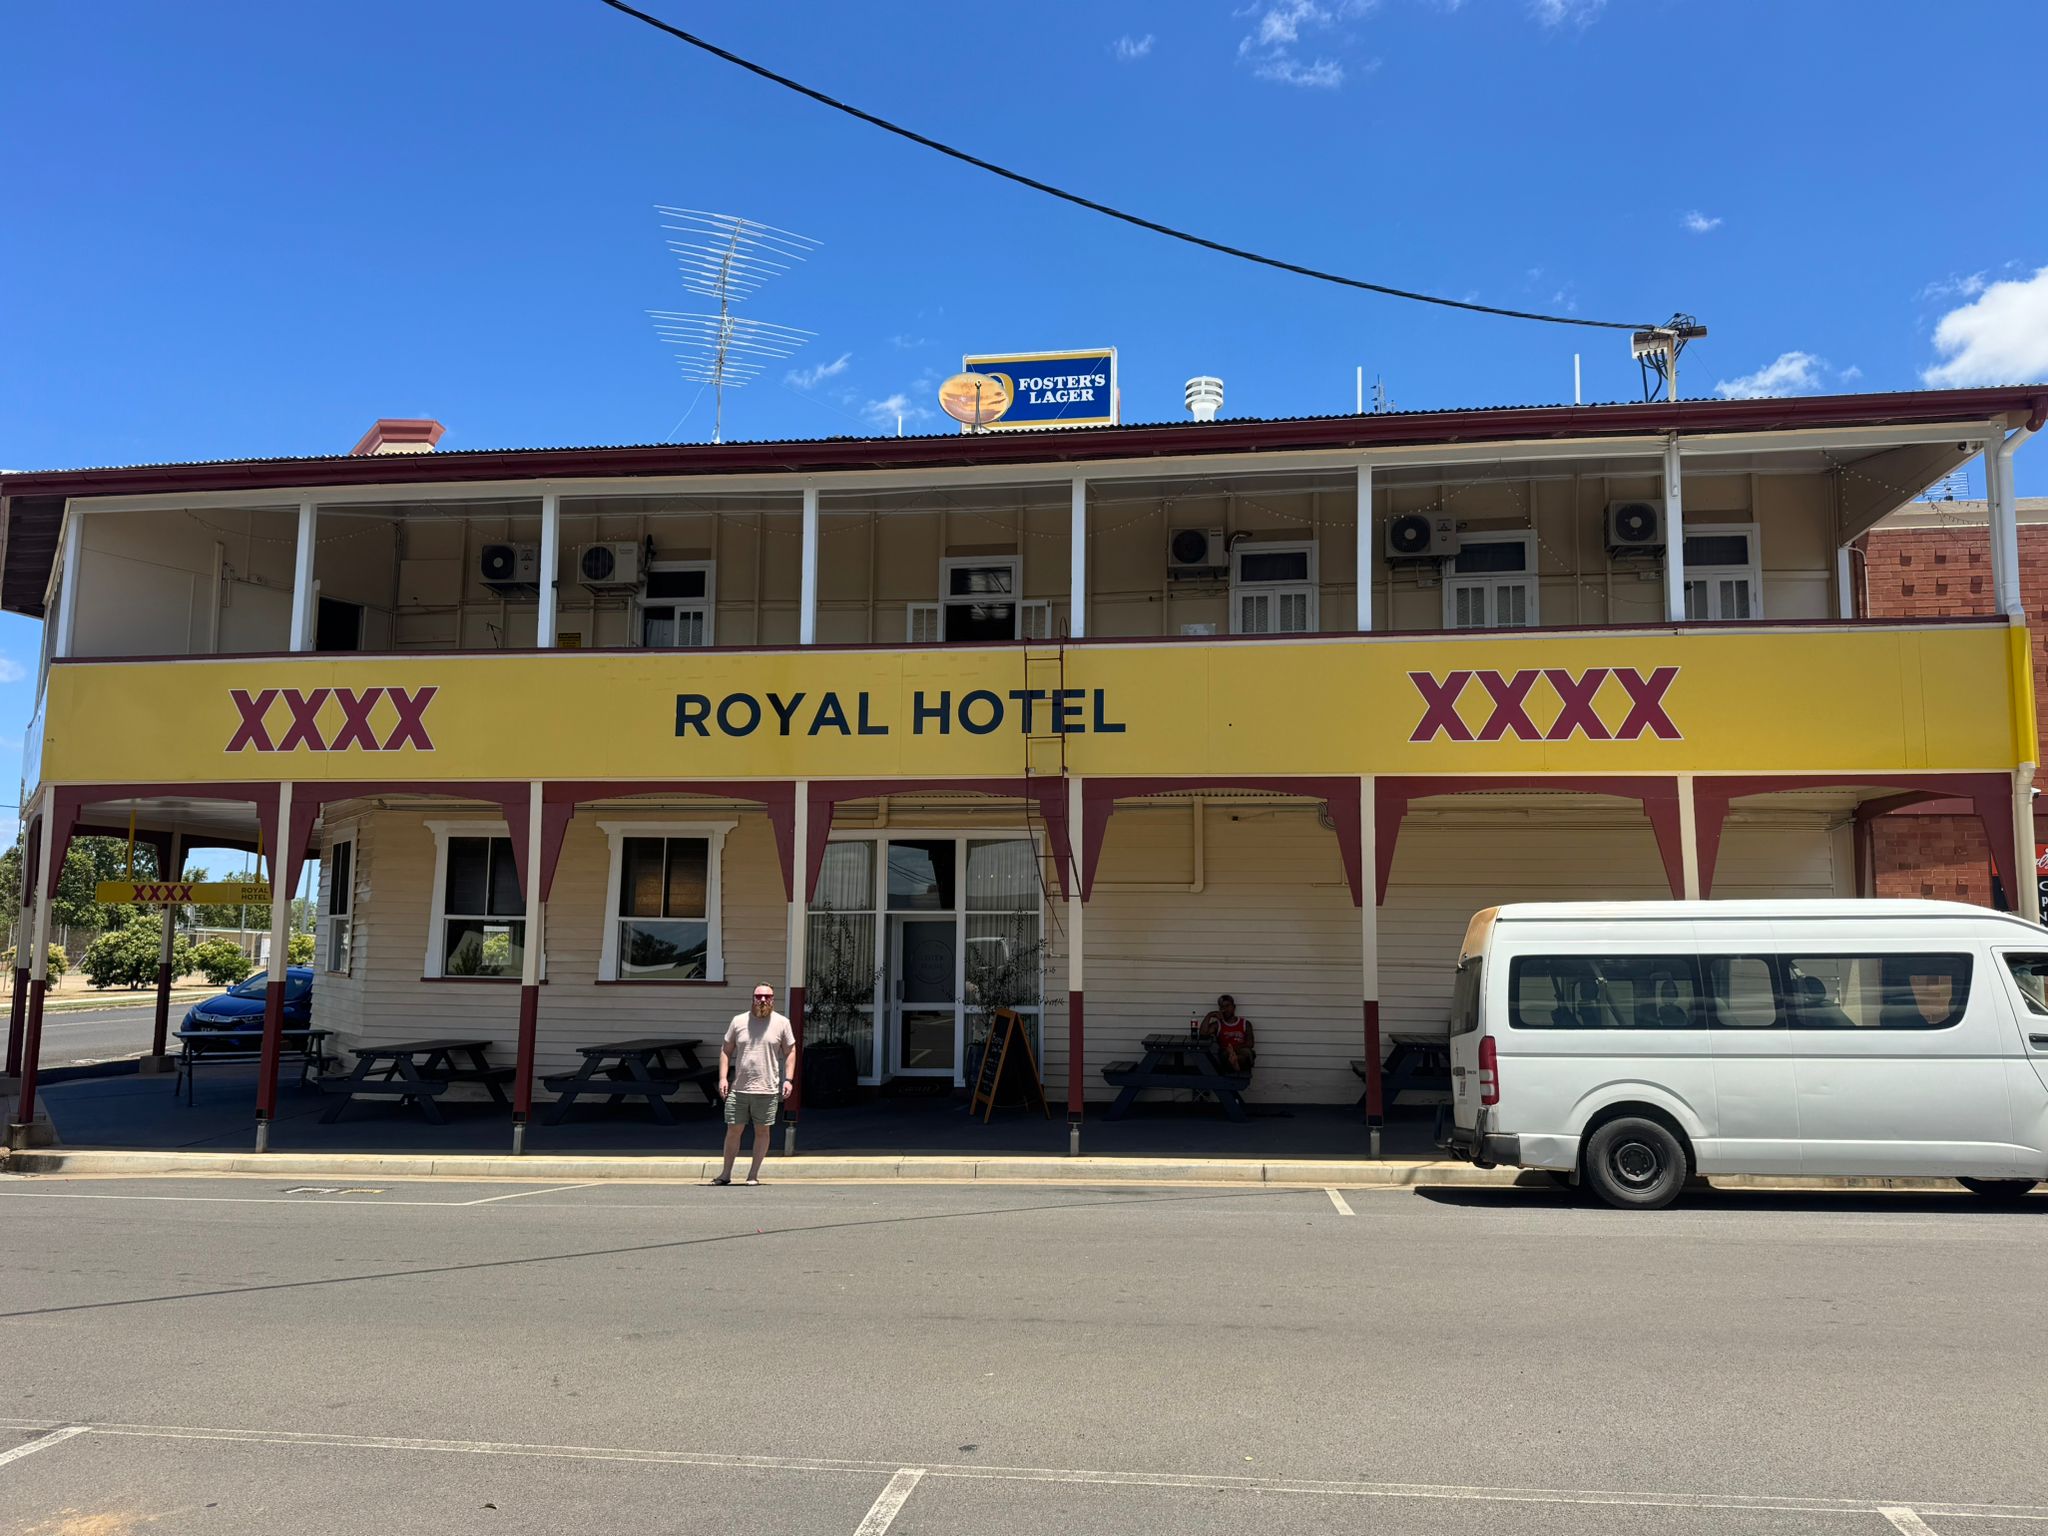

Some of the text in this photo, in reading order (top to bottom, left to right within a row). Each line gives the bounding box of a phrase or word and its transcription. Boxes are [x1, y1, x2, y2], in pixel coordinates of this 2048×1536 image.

[1019, 374, 1106, 391] FOSTER'S
[1029, 389, 1095, 404] LAGER
[225, 687, 439, 753] XXXX
[676, 687, 1126, 737] ROYAL HOTEL
[1408, 667, 1684, 742] XXXX
[132, 885, 193, 901] XXXX
